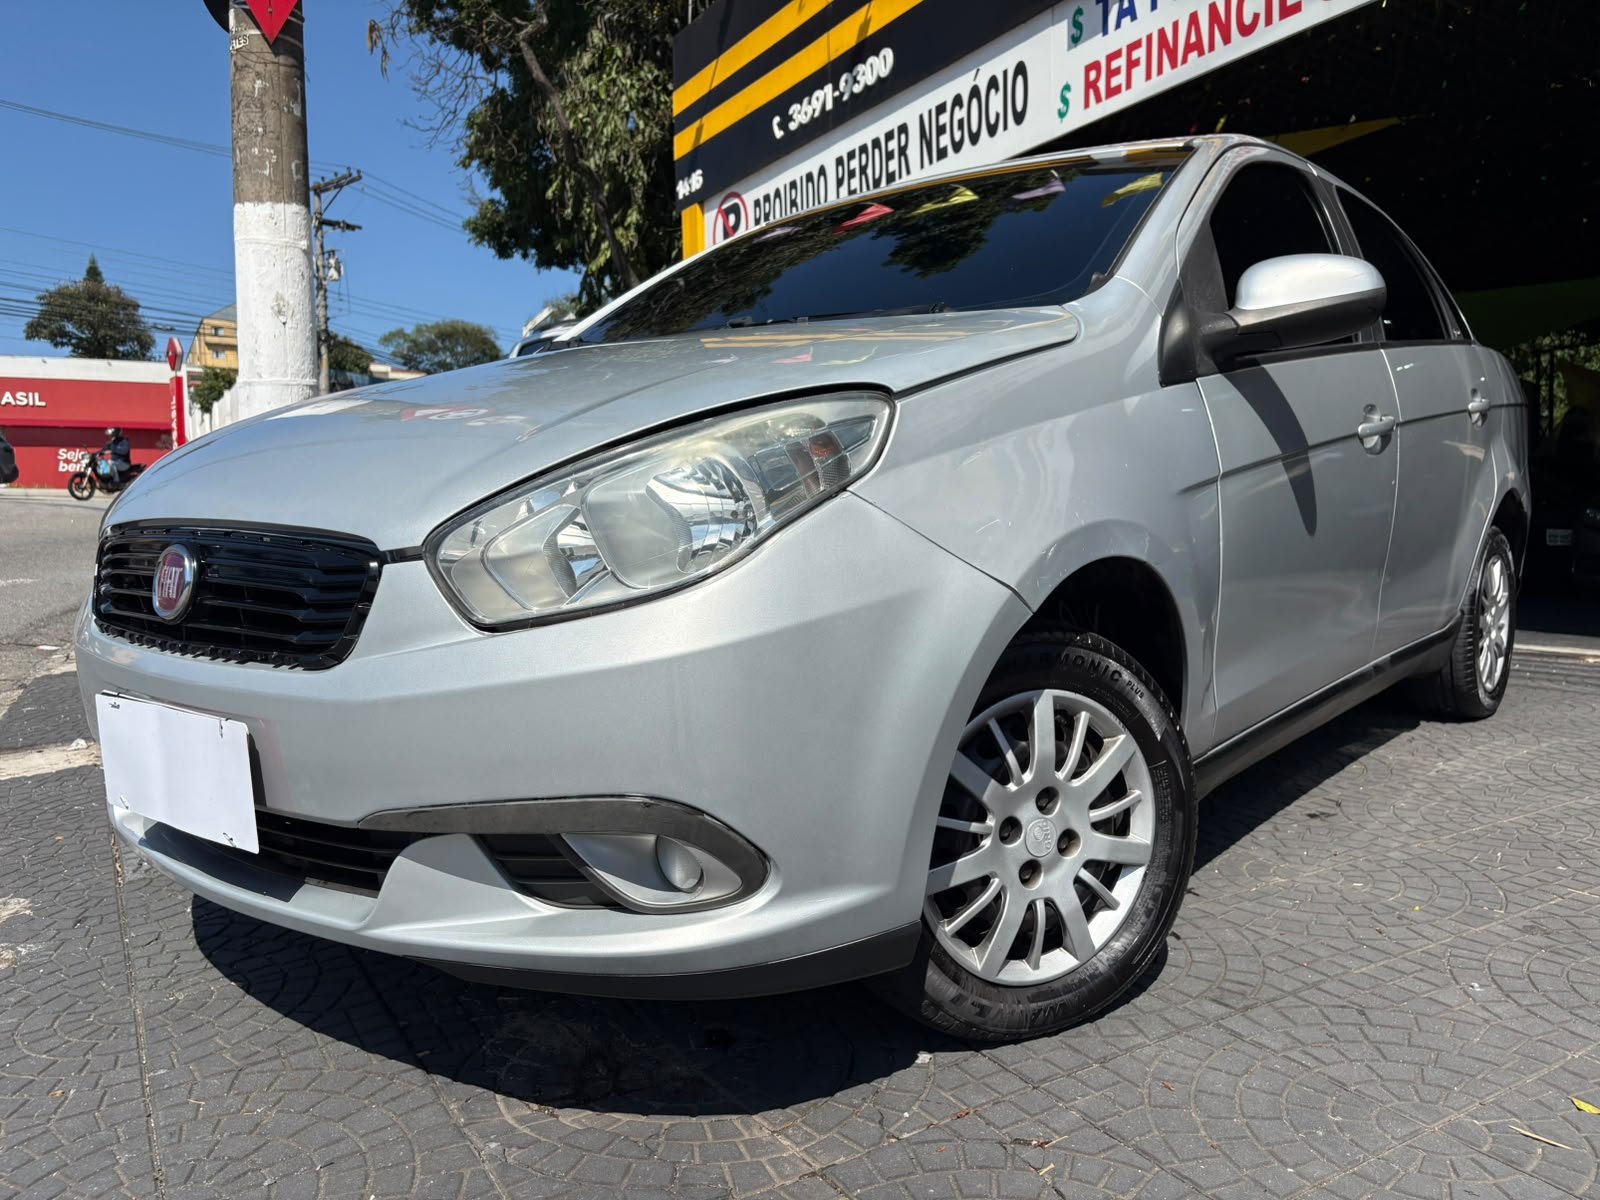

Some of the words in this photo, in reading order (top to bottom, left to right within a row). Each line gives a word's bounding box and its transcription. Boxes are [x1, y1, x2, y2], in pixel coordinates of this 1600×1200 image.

[788, 47, 894, 131] 3691-9300
[753, 164, 828, 227] PROIBIDO
[835, 122, 911, 199] PERDER
[919, 60, 1028, 170] NEGÓCIO
[1, 391, 46, 406] ASIL
